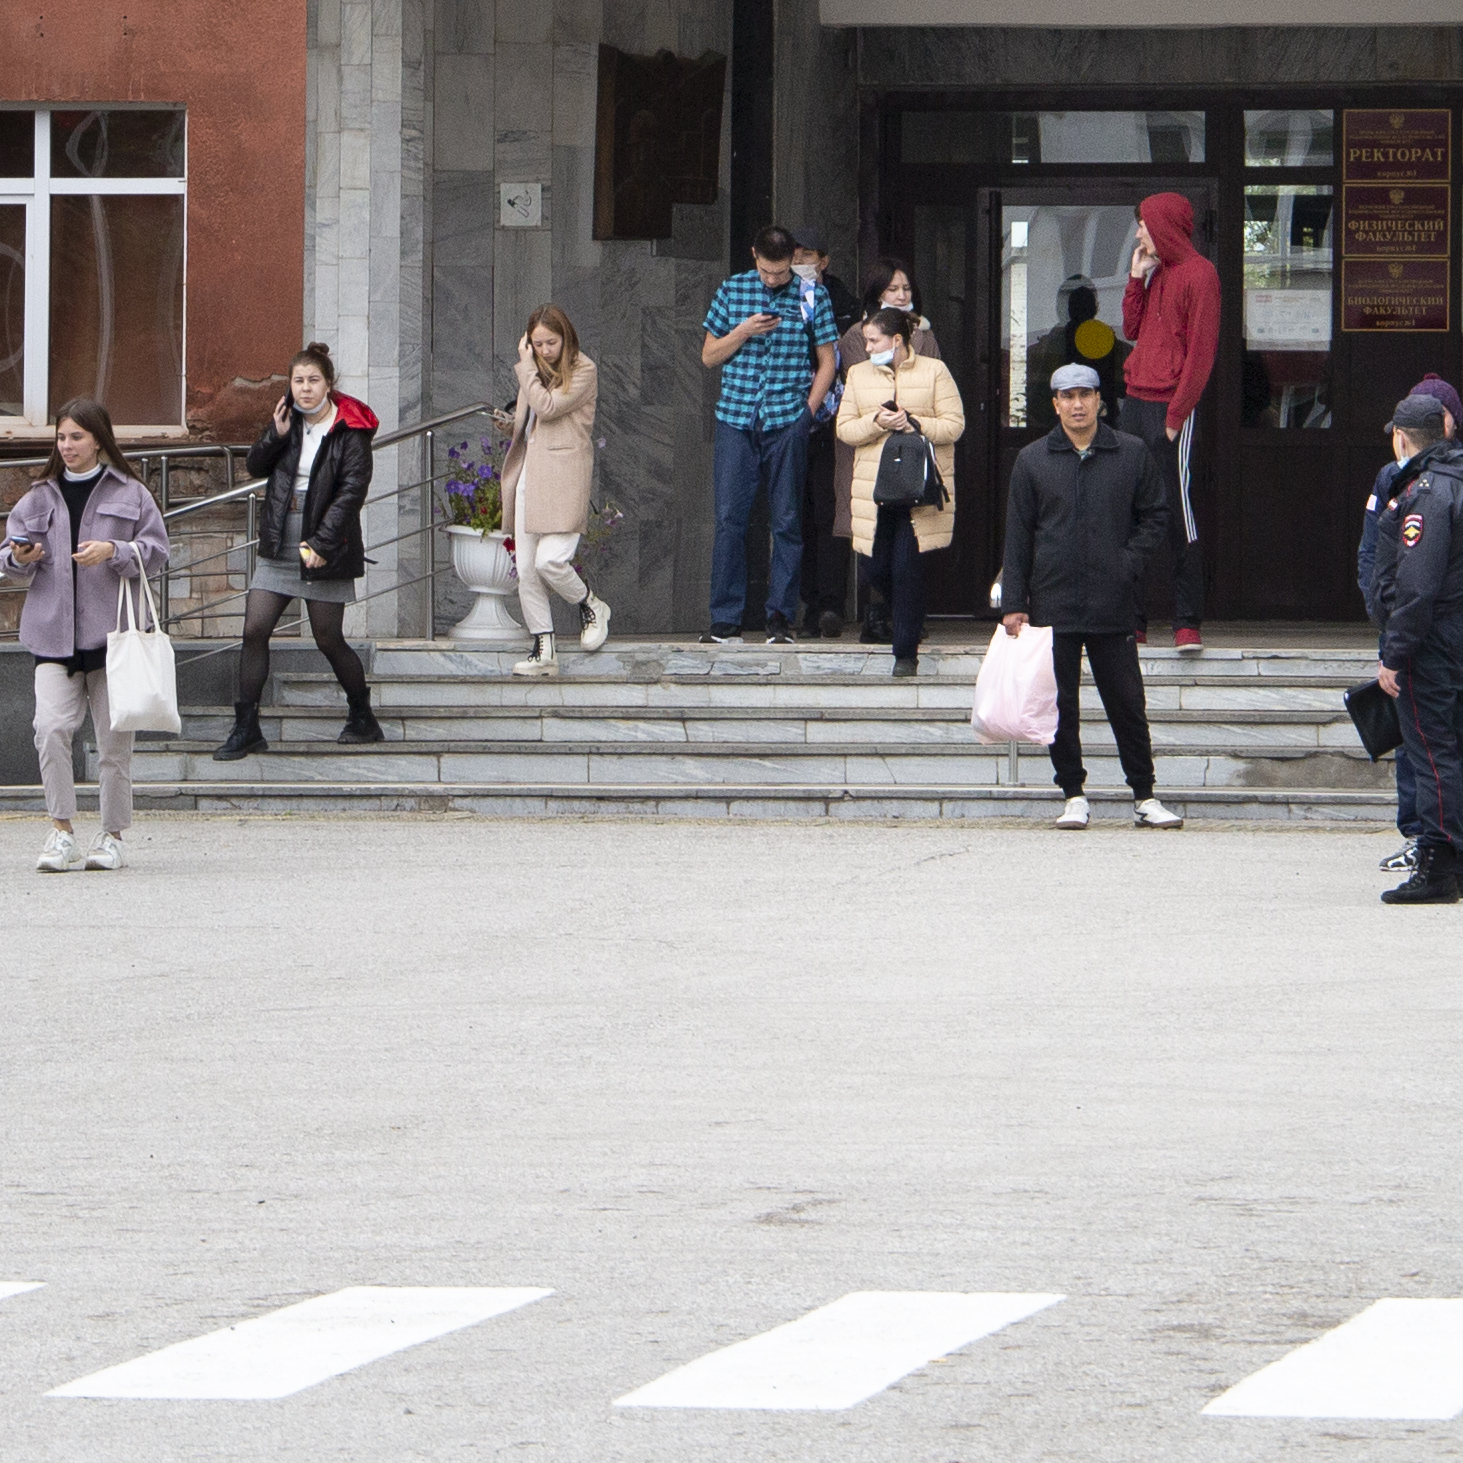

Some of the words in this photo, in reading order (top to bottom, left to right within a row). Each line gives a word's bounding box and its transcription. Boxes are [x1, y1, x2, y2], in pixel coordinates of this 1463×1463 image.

[1349, 147, 1445, 162] РЕКТОРАТ
[1347, 218, 1444, 231] ФИЗИЧЕСКИЙ
[1354, 231, 1437, 242] ФАКУЛЬТЕТ
[1347, 295, 1444, 305] БИОЛОГИЧЕСКИЙ
[1362, 306, 1428, 315] ФАКУЛЬТЕТ
